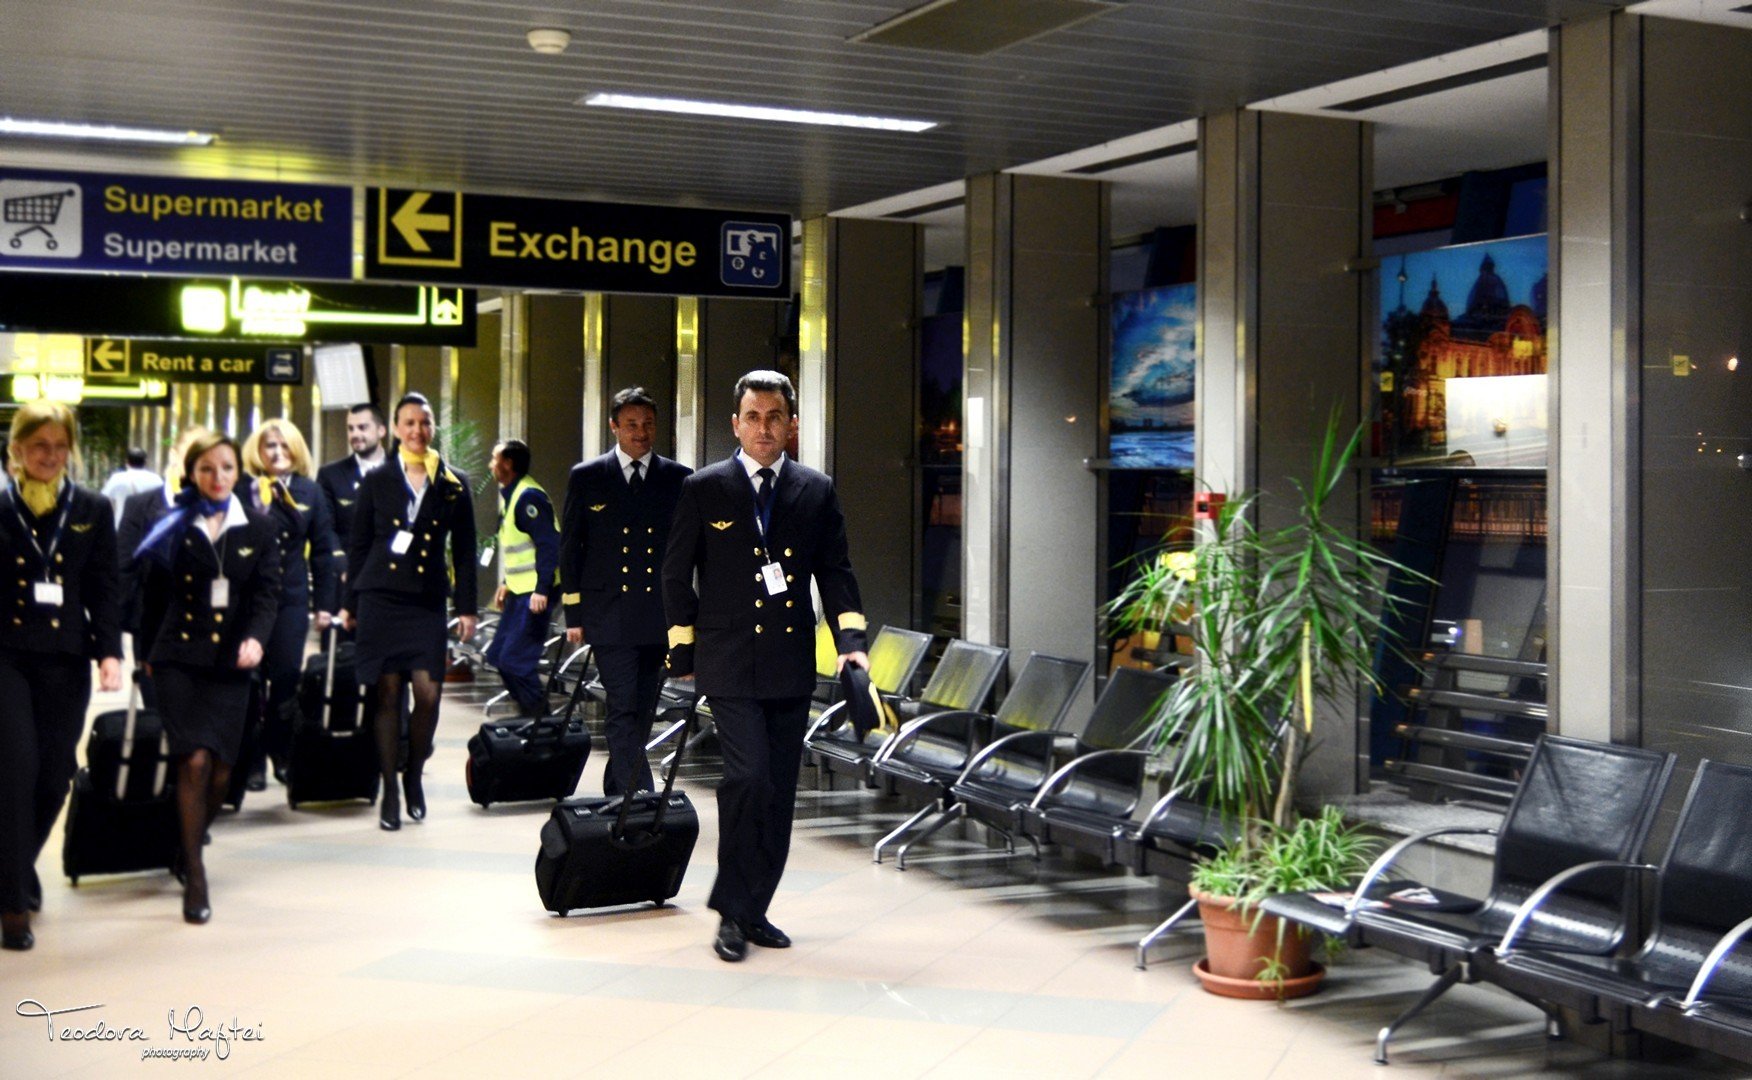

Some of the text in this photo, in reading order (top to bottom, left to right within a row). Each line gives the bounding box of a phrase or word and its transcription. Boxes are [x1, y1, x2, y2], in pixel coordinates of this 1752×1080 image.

[104, 185, 324, 222] Supermarket
[103, 233, 298, 264] Supermarket
[490, 221, 697, 274] Exchange
[142, 352, 254, 372] Rent a car
